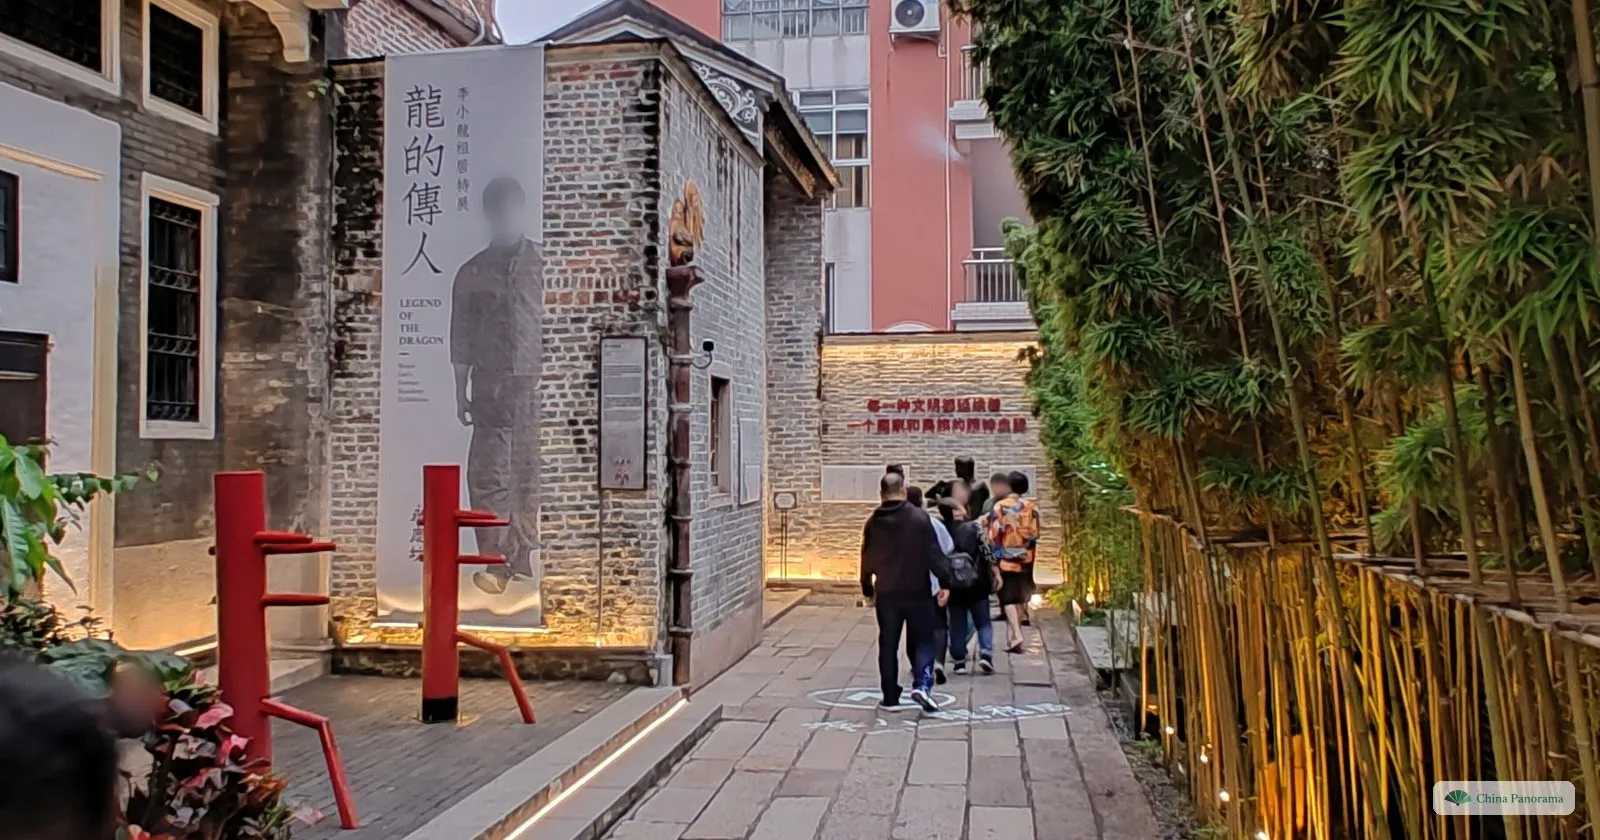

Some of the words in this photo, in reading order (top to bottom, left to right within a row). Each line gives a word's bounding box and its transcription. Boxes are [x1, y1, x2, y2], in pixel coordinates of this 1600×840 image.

[401, 84, 445, 276] 龍的傳人
[399, 299, 442, 308] LEGEND
[399, 311, 413, 320] OF
[400, 323, 420, 333] THE
[399, 336, 444, 345] DRAGON
